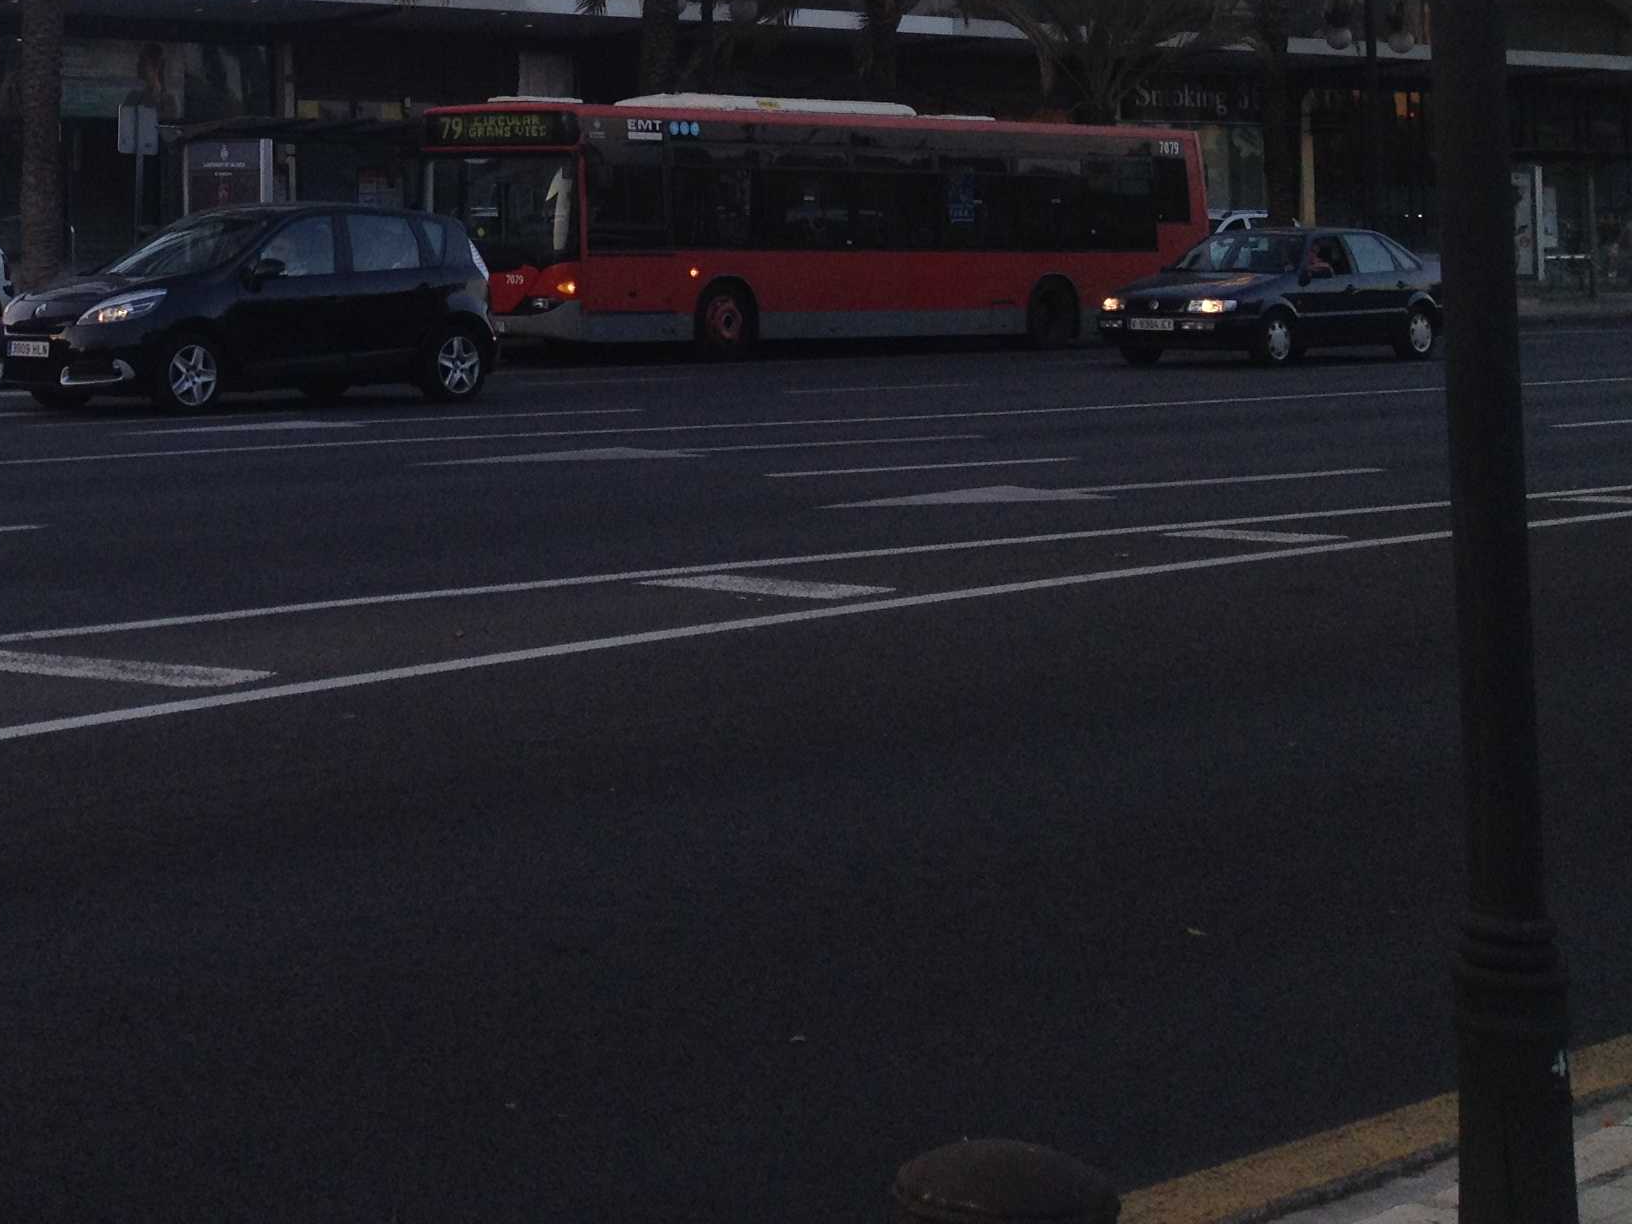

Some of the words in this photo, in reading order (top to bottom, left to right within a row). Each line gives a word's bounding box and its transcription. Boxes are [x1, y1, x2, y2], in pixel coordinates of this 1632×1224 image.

[439, 117, 463, 140] 79
[627, 119, 663, 131] EMT
[1159, 141, 1180, 154] 7079
[505, 274, 524, 285] 7079
